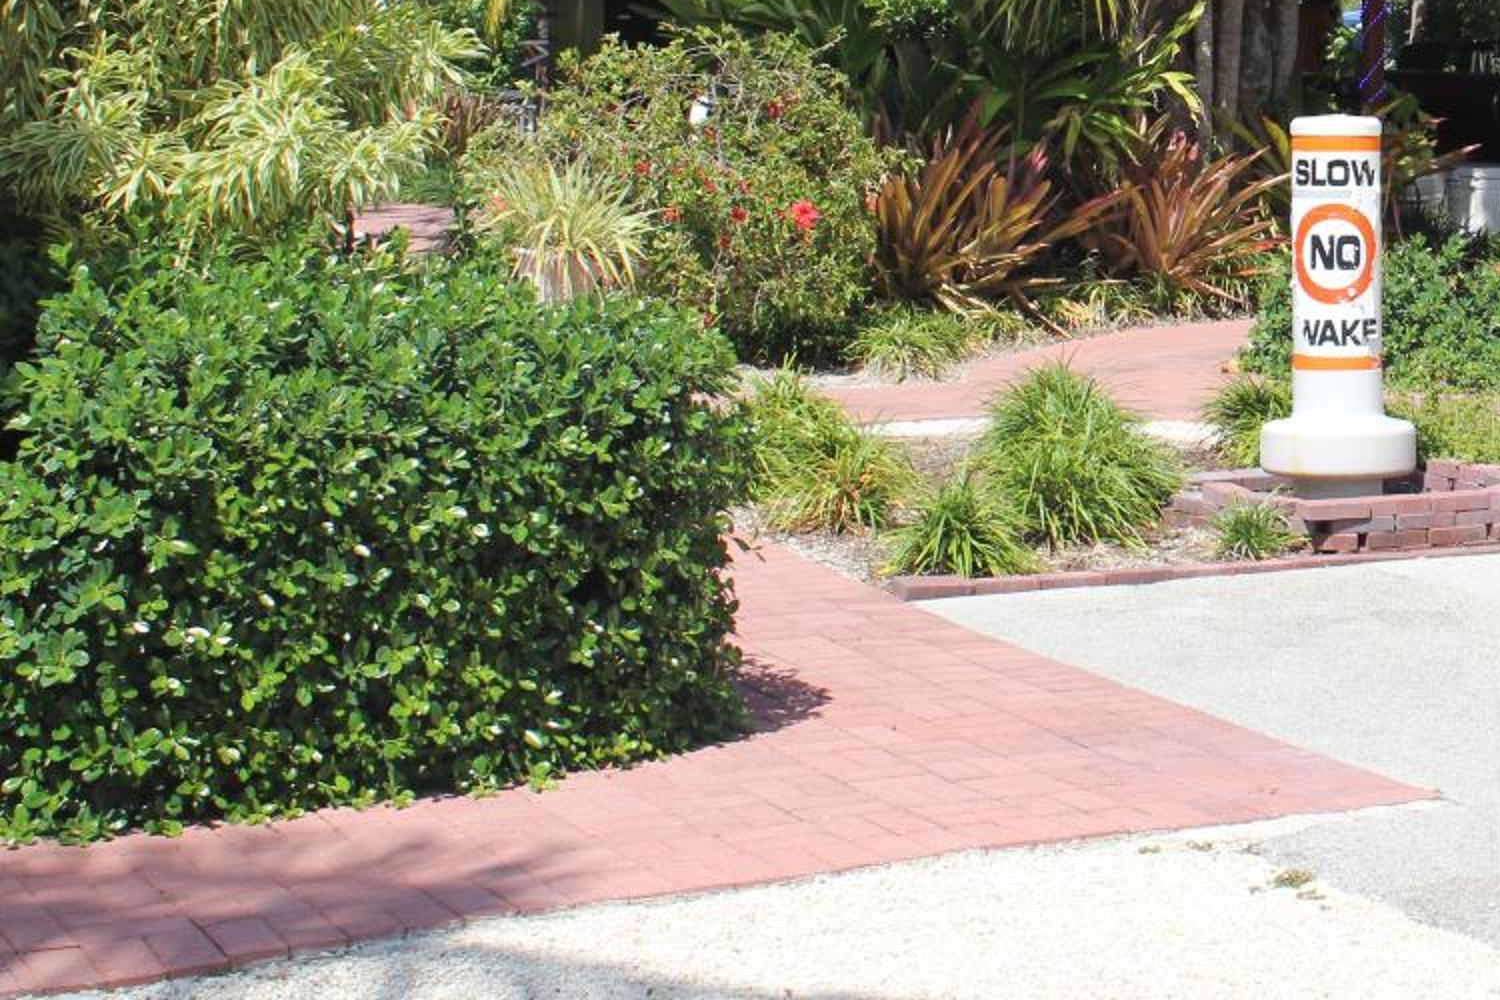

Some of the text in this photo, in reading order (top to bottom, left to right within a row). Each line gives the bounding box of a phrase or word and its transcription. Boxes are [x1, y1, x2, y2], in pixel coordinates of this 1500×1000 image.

[1295, 159, 1375, 187] SLOW
[1310, 234, 1361, 271] NO
[1303, 318, 1376, 347] WAKE
